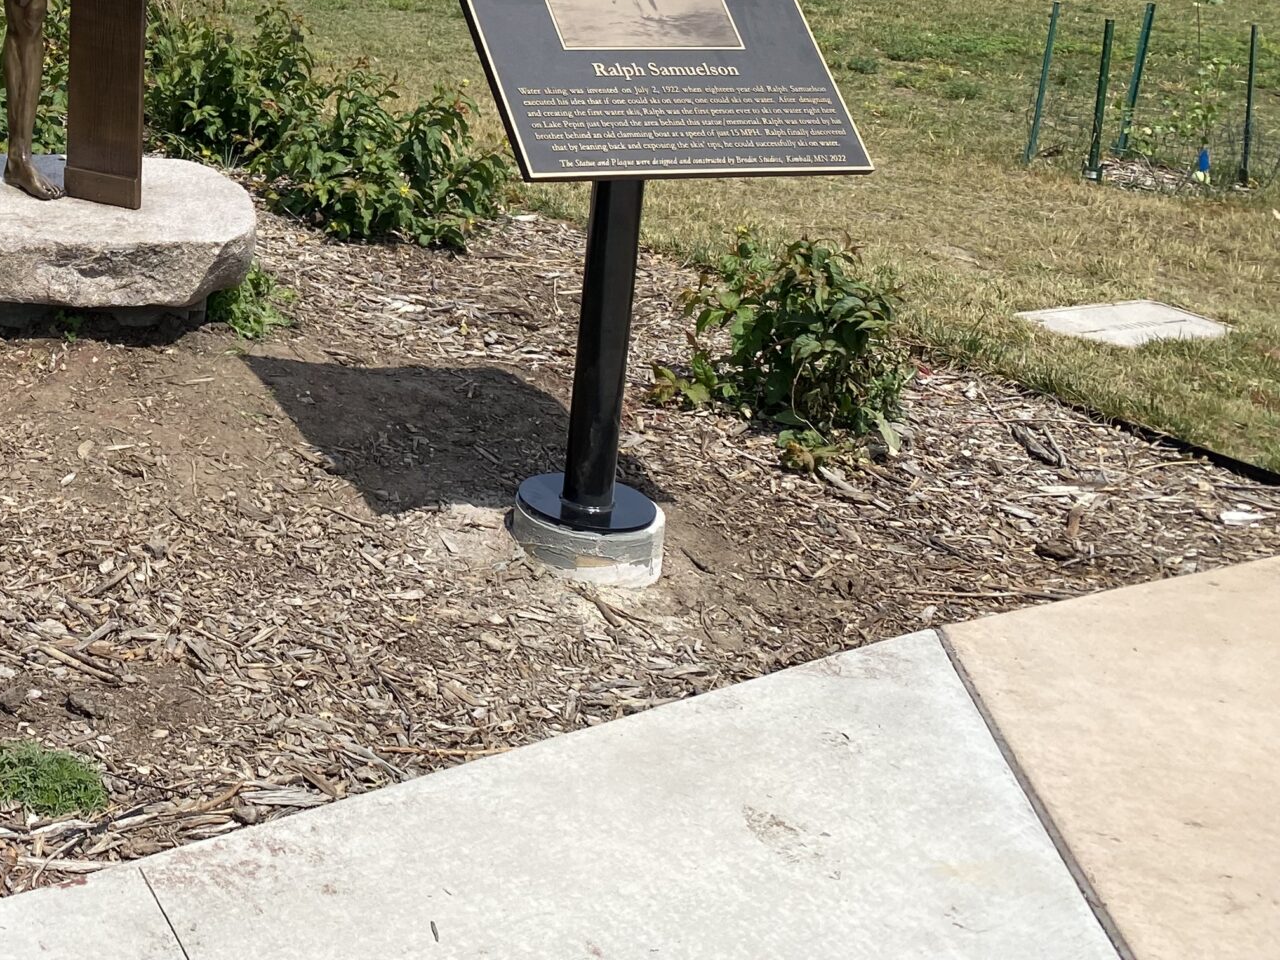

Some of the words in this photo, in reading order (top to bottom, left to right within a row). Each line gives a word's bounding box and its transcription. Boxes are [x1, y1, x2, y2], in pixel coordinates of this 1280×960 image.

[592, 63, 646, 80] Ralph
[648, 63, 739, 76] Samuelson
[544, 87, 567, 96] skiing
[635, 87, 648, 95] July
[767, 86, 788, 94] Ralph
[543, 110, 572, 118] creating
[643, 108, 664, 118] Ralph
[563, 121, 584, 129] Pepin
[586, 120, 601, 128] just
[602, 120, 629, 129] beyond
[762, 118, 783, 126] Ralph
[686, 130, 706, 138] speed
[765, 129, 786, 137] Ralph
[787, 129, 808, 137] finally
[569, 144, 578, 152] by
[580, 143, 608, 152] leaning
[643, 142, 676, 151] exposing
[575, 159, 595, 167] Statue
[612, 159, 634, 168] Plaque
[652, 158, 677, 166] designed
